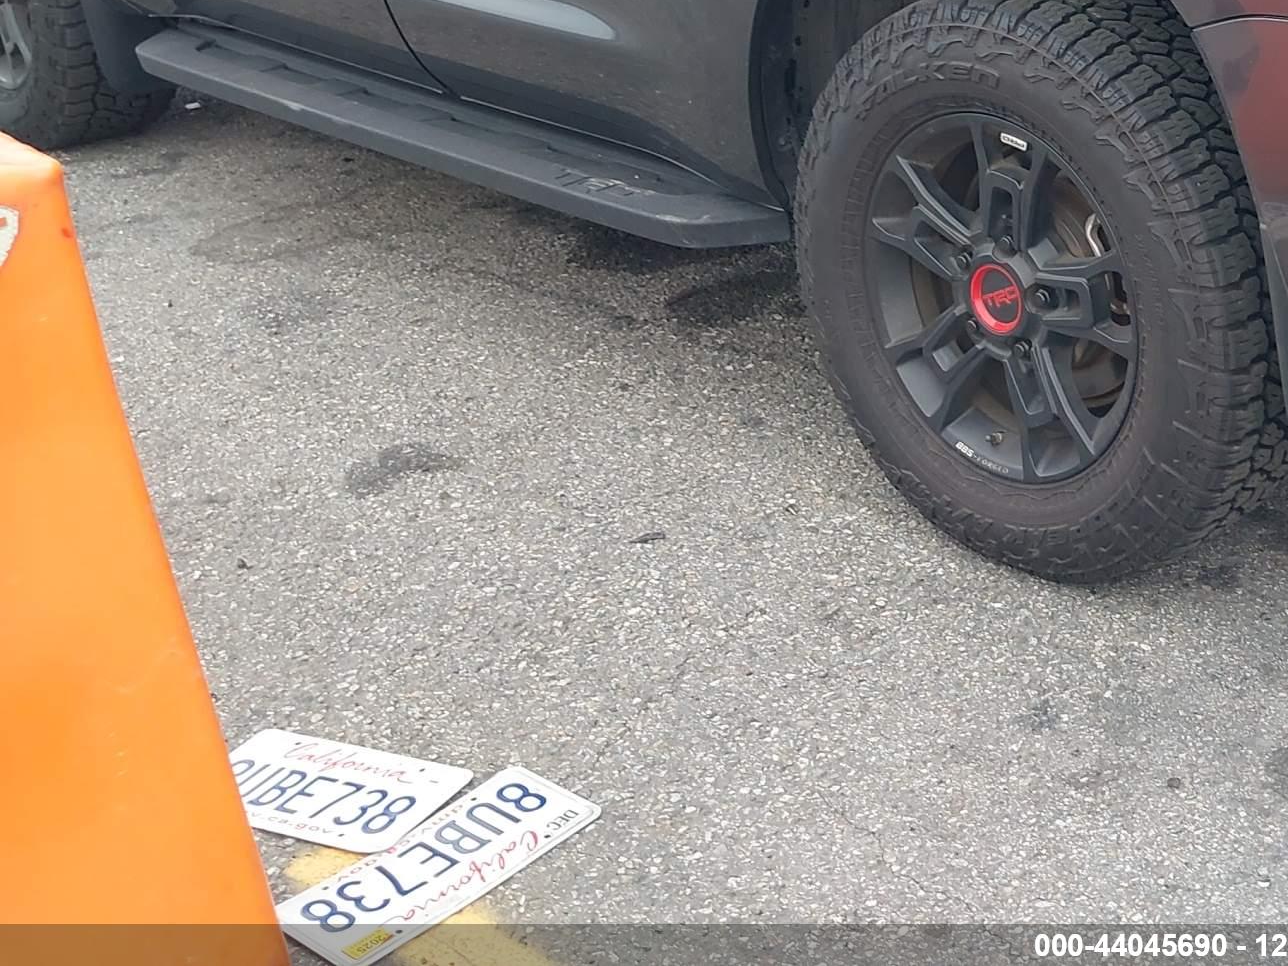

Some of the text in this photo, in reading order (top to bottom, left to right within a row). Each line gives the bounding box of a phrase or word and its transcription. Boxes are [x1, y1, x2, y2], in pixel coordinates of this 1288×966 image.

[283, 742, 411, 784] California
[547, 807, 579, 830] DEC
[301, 782, 547, 933] 8UBE738
[381, 830, 539, 924] California
[356, 934, 387, 954] 2025
